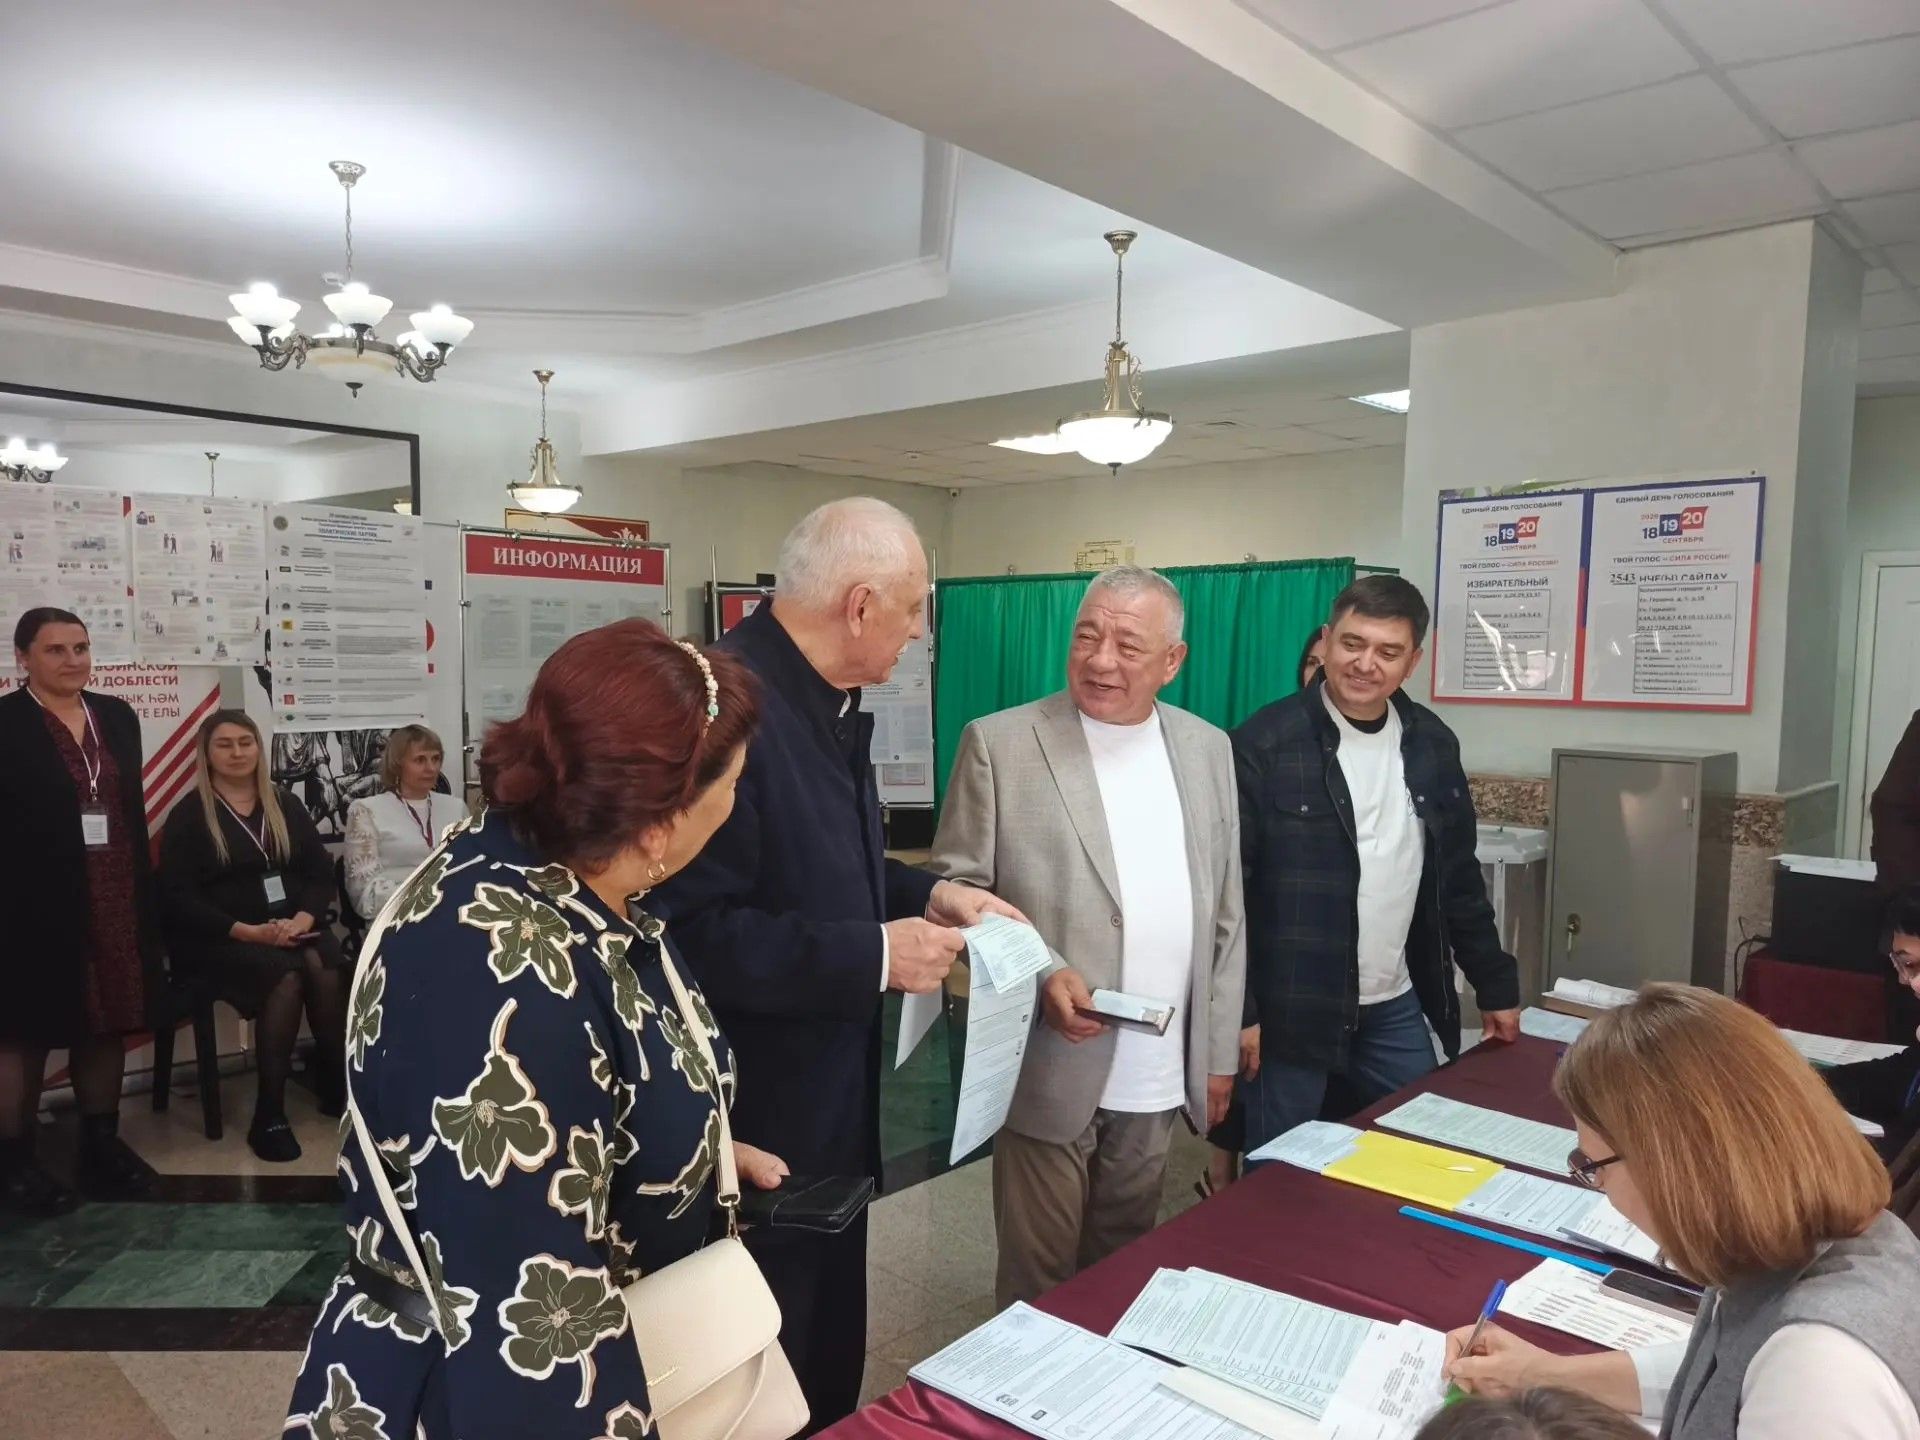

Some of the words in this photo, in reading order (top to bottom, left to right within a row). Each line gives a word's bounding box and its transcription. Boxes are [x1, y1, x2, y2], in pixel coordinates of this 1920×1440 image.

[1615, 495, 1649, 504] ЕДИНЫЙ
[1650, 494, 1672, 502] ДЕНЬ
[1673, 490, 1735, 500] ГОЛОСОВАНИЯ
[1461, 506, 1490, 514] ЕДИНЫЙ
[1510, 501, 1563, 510] ГОЛОСОВАНИЯ
[1642, 527, 1658, 539] 18
[1661, 519, 1679, 532] 19
[1681, 511, 1703, 525] 20
[1485, 535, 1498, 547] 18
[1500, 528, 1515, 541] 19
[1517, 521, 1536, 534] 20
[1662, 536, 1704, 544] СЕНТЯБРЯ
[493, 547, 643, 576] ИНФОРМАЦИЯ
[1466, 577, 1549, 588] ИЗБИРАТЕЛЬНЫЙ
[103, 676, 179, 688] ДОБЛЕСТИ
[153, 707, 180, 718] ЕЛЫ
